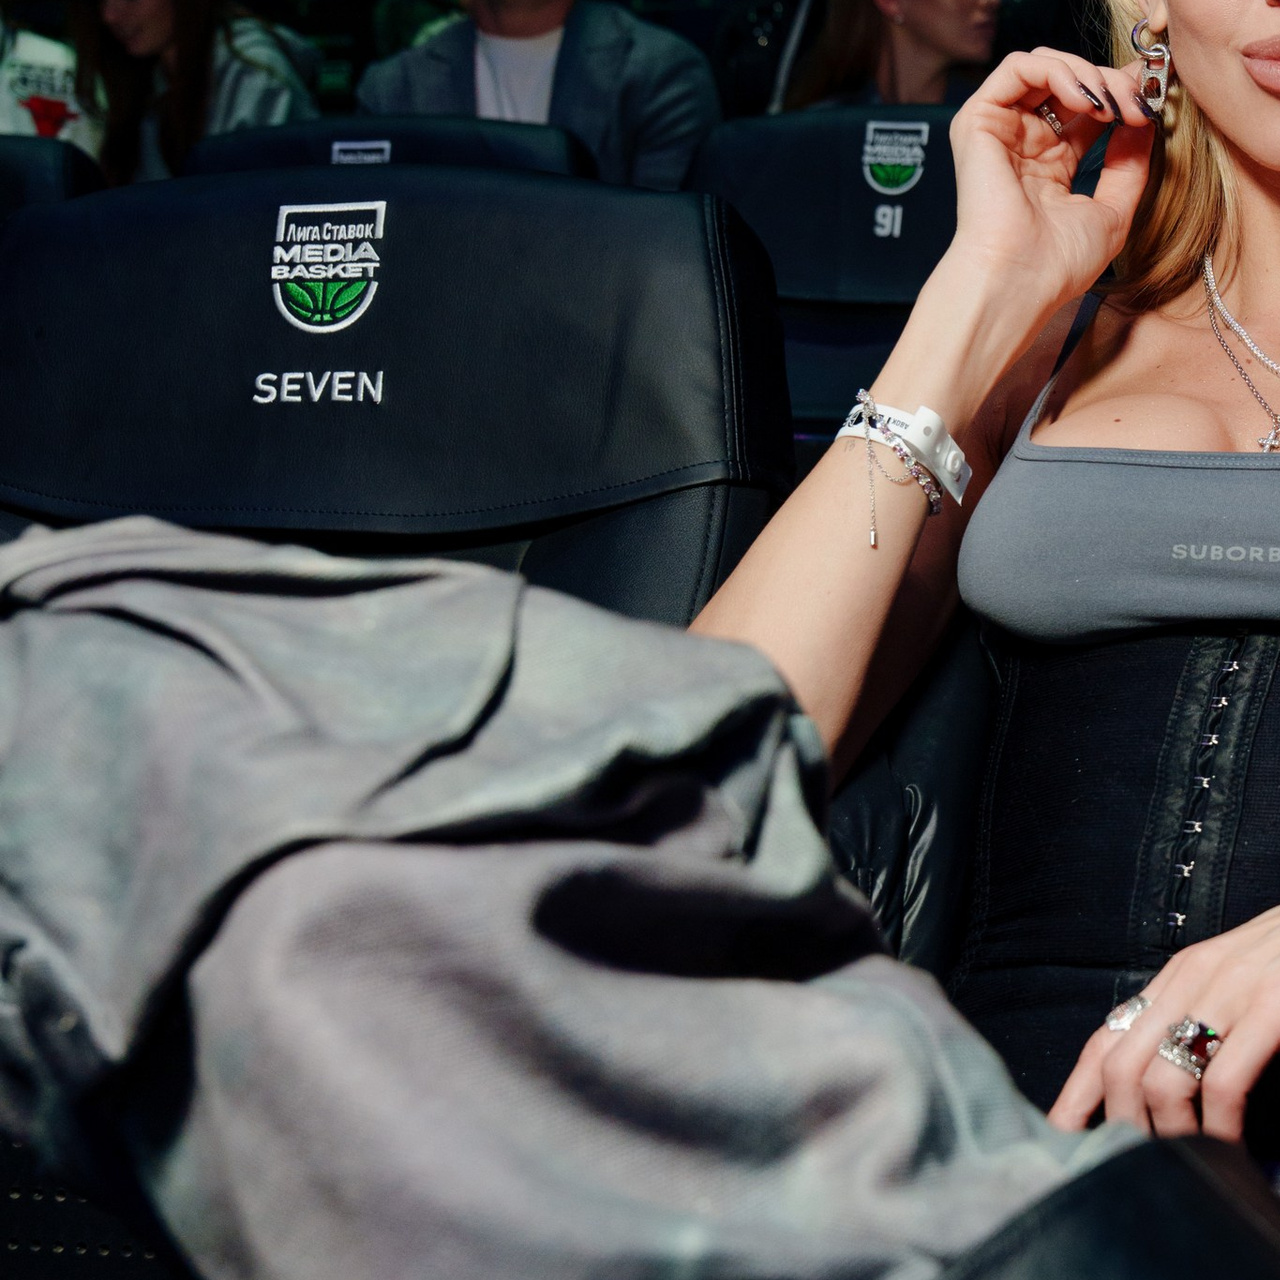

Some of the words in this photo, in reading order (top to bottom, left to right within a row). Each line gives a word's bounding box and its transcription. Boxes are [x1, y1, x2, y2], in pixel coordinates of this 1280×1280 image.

[873, 204, 903, 238] 91
[273, 241, 380, 264] MEDIA
[271, 262, 380, 280] BASKET
[253, 370, 384, 405] SEVEN
